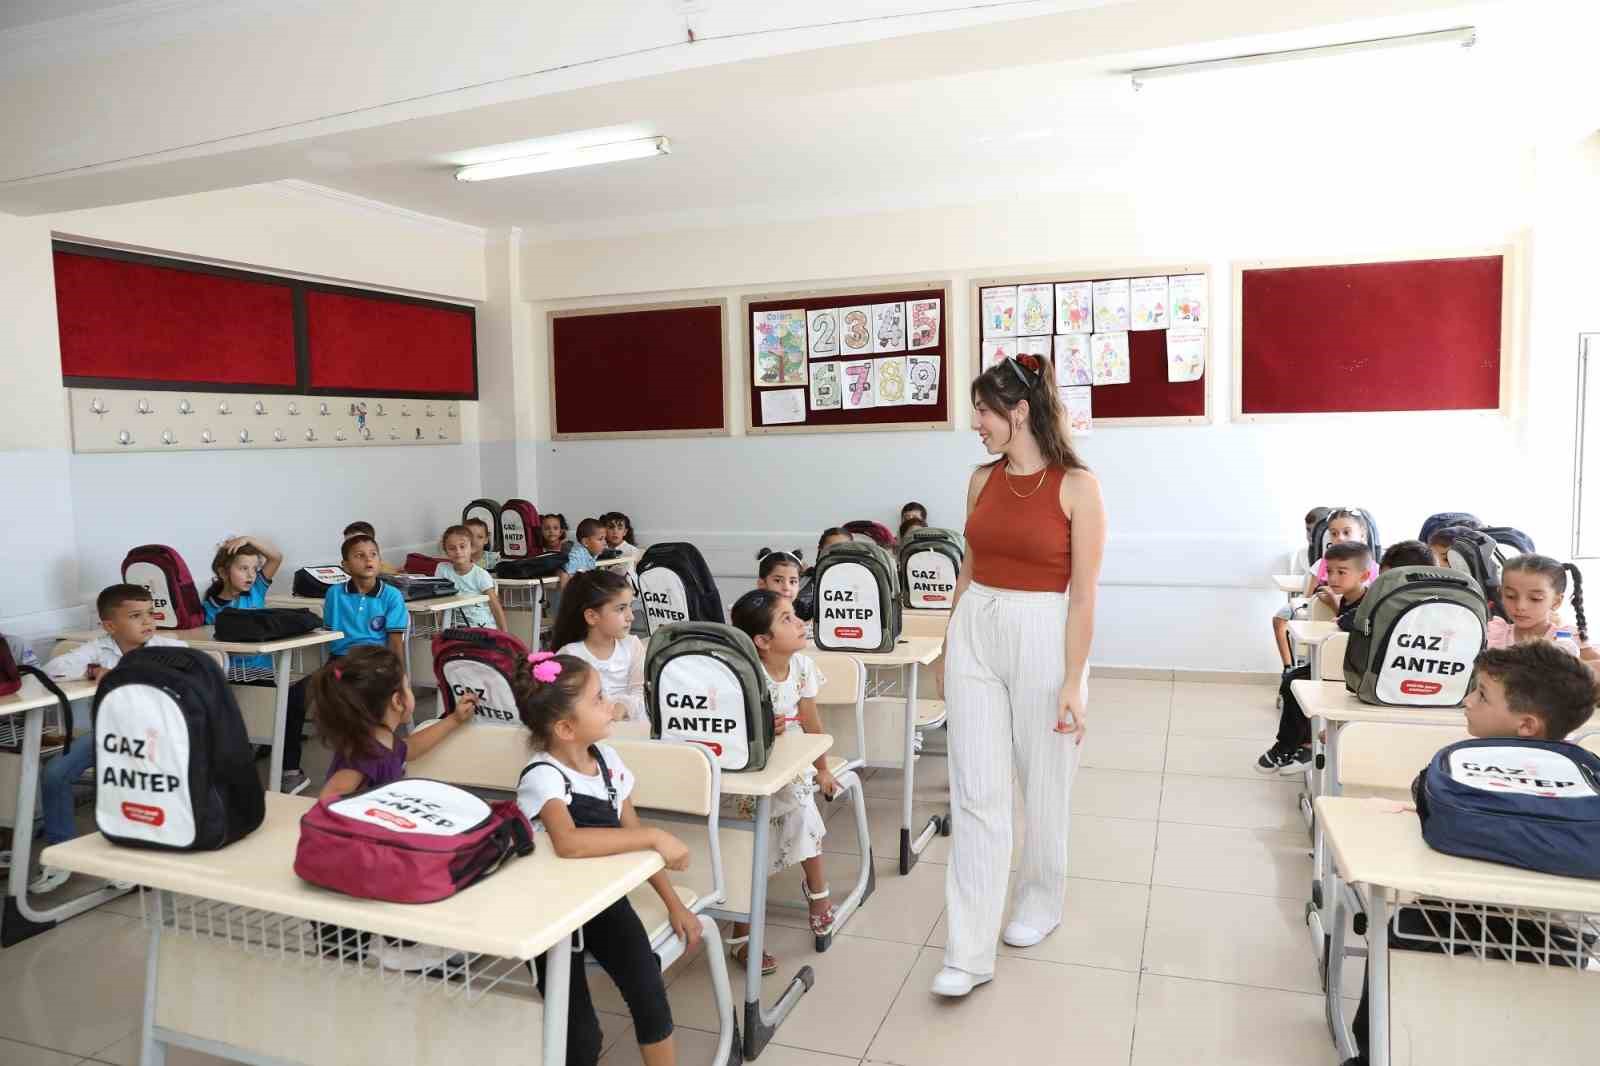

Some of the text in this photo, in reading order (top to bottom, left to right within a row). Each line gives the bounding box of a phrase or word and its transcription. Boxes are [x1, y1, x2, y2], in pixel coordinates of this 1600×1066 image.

[813, 313, 835, 353] 2
[845, 311, 870, 349] 3
[912, 303, 936, 346] 5
[846, 365, 871, 405] 7
[880, 361, 905, 401] 8
[913, 583, 954, 593] ANTEP
[648, 607, 686, 622] ANTEP
[824, 608, 874, 620] ANTEP
[1391, 655, 1466, 676] ANTEP
[473, 703, 514, 722] NTEP
[667, 716, 738, 734] ANTEP
[103, 766, 181, 793] ANTEP
